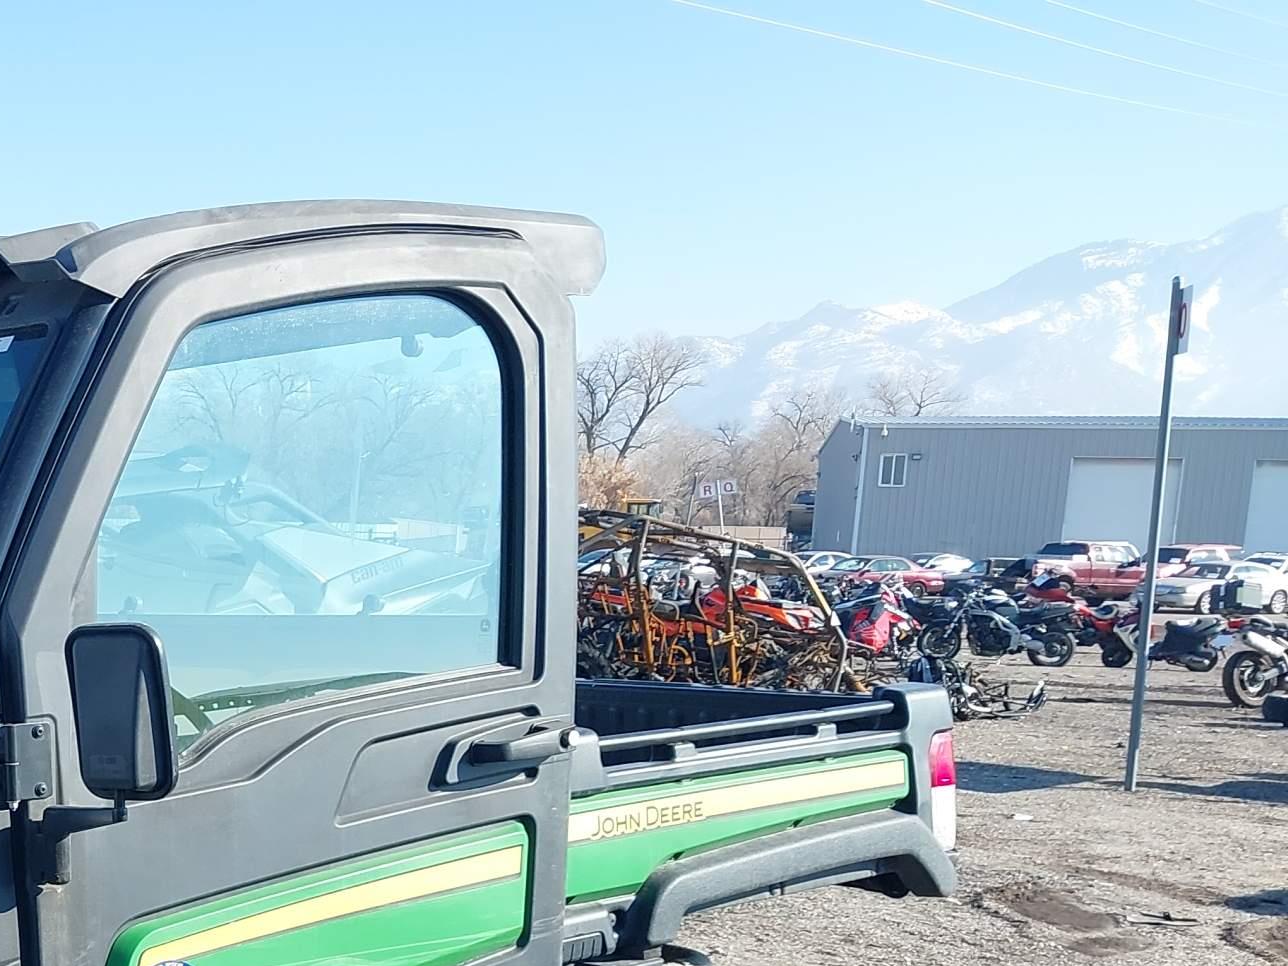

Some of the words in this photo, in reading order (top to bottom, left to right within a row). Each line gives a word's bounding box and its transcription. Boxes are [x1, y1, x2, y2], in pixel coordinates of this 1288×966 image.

[703, 485, 712, 496] R
[723, 482, 734, 493] Q
[592, 812, 641, 837] JOHN
[646, 801, 704, 826] DEERE
